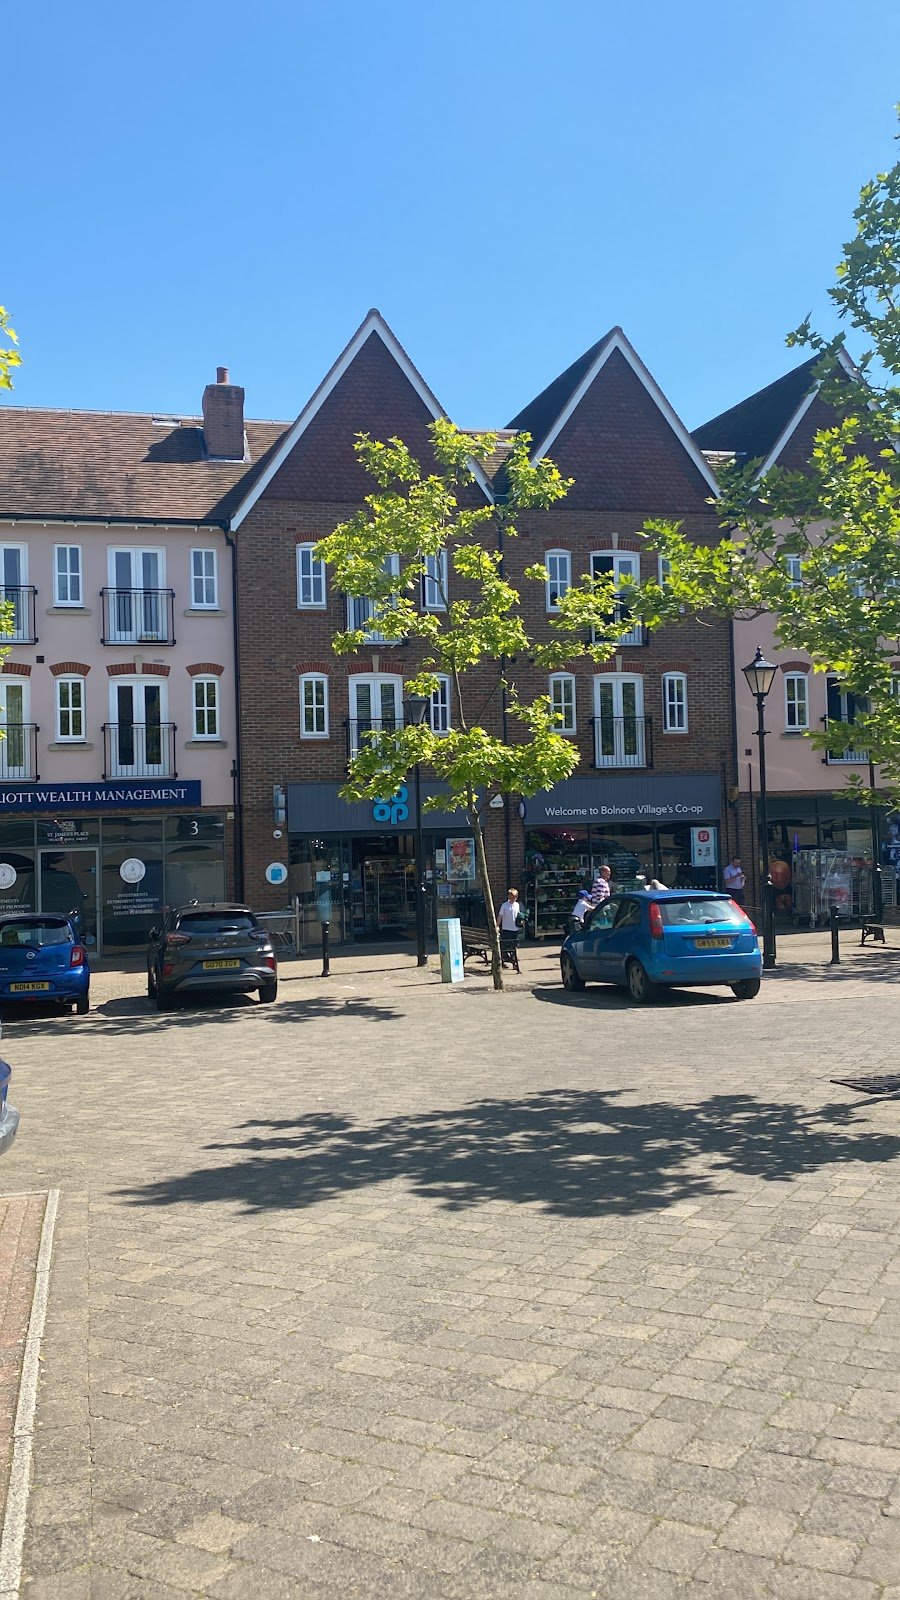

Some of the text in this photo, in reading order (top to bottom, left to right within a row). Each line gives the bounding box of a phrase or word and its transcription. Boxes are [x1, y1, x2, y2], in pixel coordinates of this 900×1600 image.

[36, 791, 92, 803] WEALTH
[95, 788, 187, 801] MANAGEMENT
[545, 803, 703, 816] Welcome to Bolnore Village's Co-op
[190, 820, 199, 836] 3
